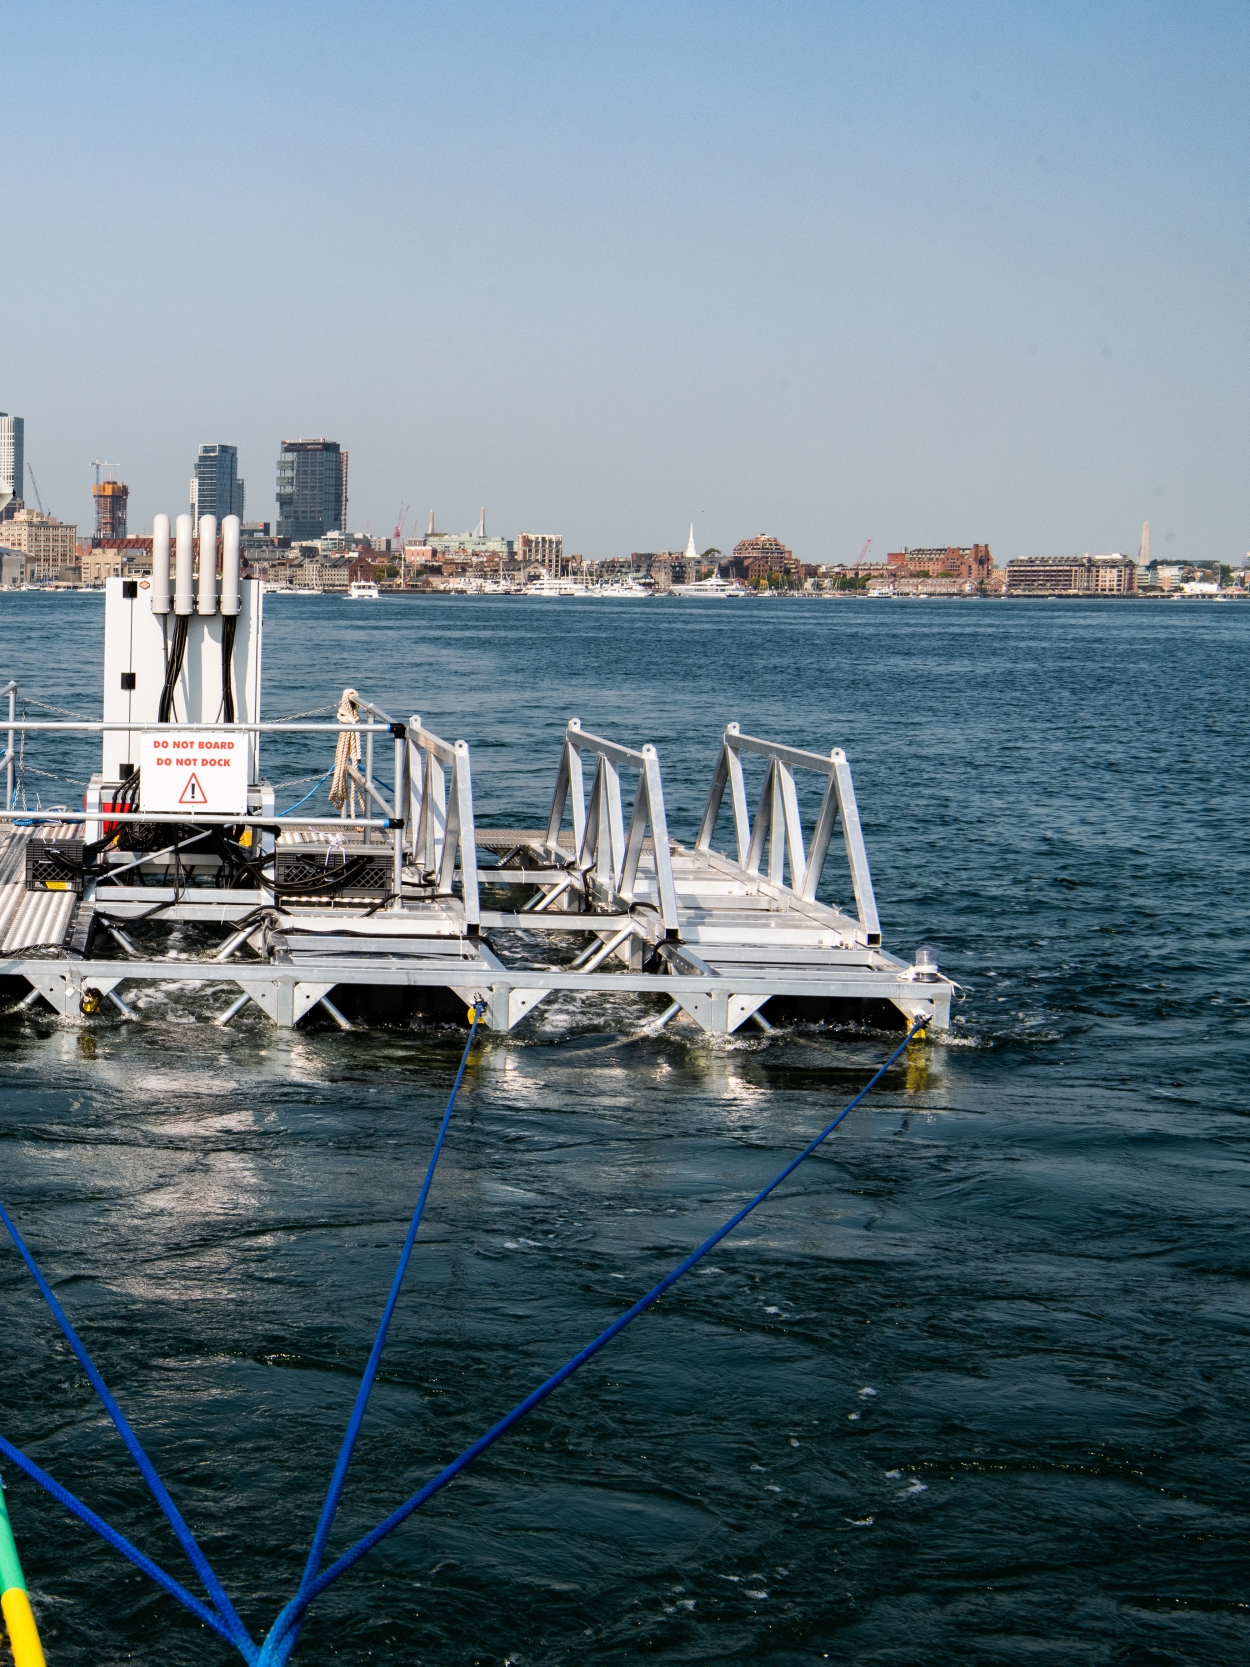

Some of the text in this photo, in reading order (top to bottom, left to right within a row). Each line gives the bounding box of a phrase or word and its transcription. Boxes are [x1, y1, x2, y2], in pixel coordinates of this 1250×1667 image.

[153, 740, 235, 750] DO NOT BOARD
[156, 757, 231, 767] DO NOT DOCK
